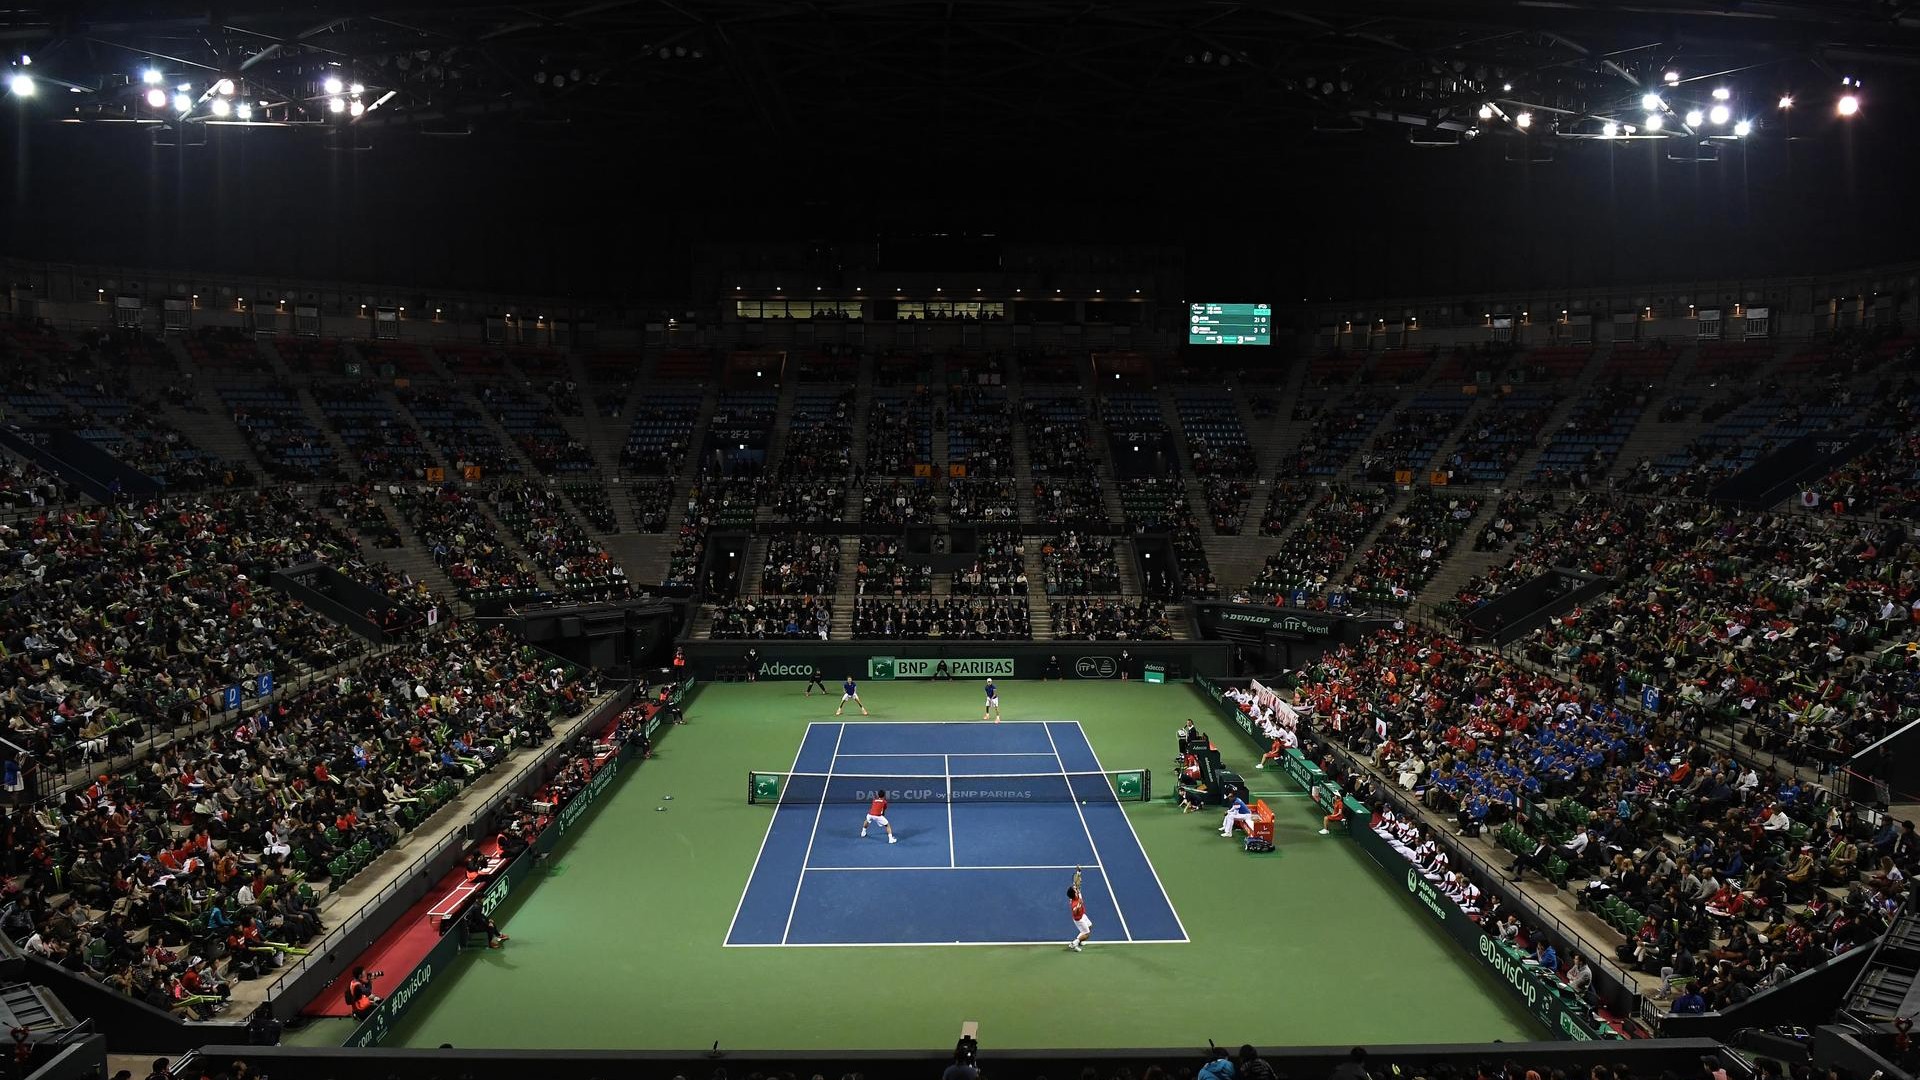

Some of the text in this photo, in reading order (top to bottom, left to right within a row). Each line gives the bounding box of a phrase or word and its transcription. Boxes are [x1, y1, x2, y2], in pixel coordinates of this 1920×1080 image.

[1229, 613, 1270, 624] DUNLOP
[1272, 621, 1328, 634] an ITF event
[759, 661, 813, 676] Adecco
[898, 661, 1012, 674] BNP PARIBAS
[1145, 664, 1165, 672] Adecco
[262, 675, 269, 689] C
[229, 688, 236, 702] D
[903, 789, 932, 800] CUP
[952, 790, 978, 799] BNP
[980, 790, 1033, 799] PARIBAS
[1418, 879, 1437, 900] JAPAN
[1418, 890, 1446, 920] AIRLINES
[1479, 934, 1537, 1008] @DavisCup
[391, 963, 431, 1016] #DavisCup
